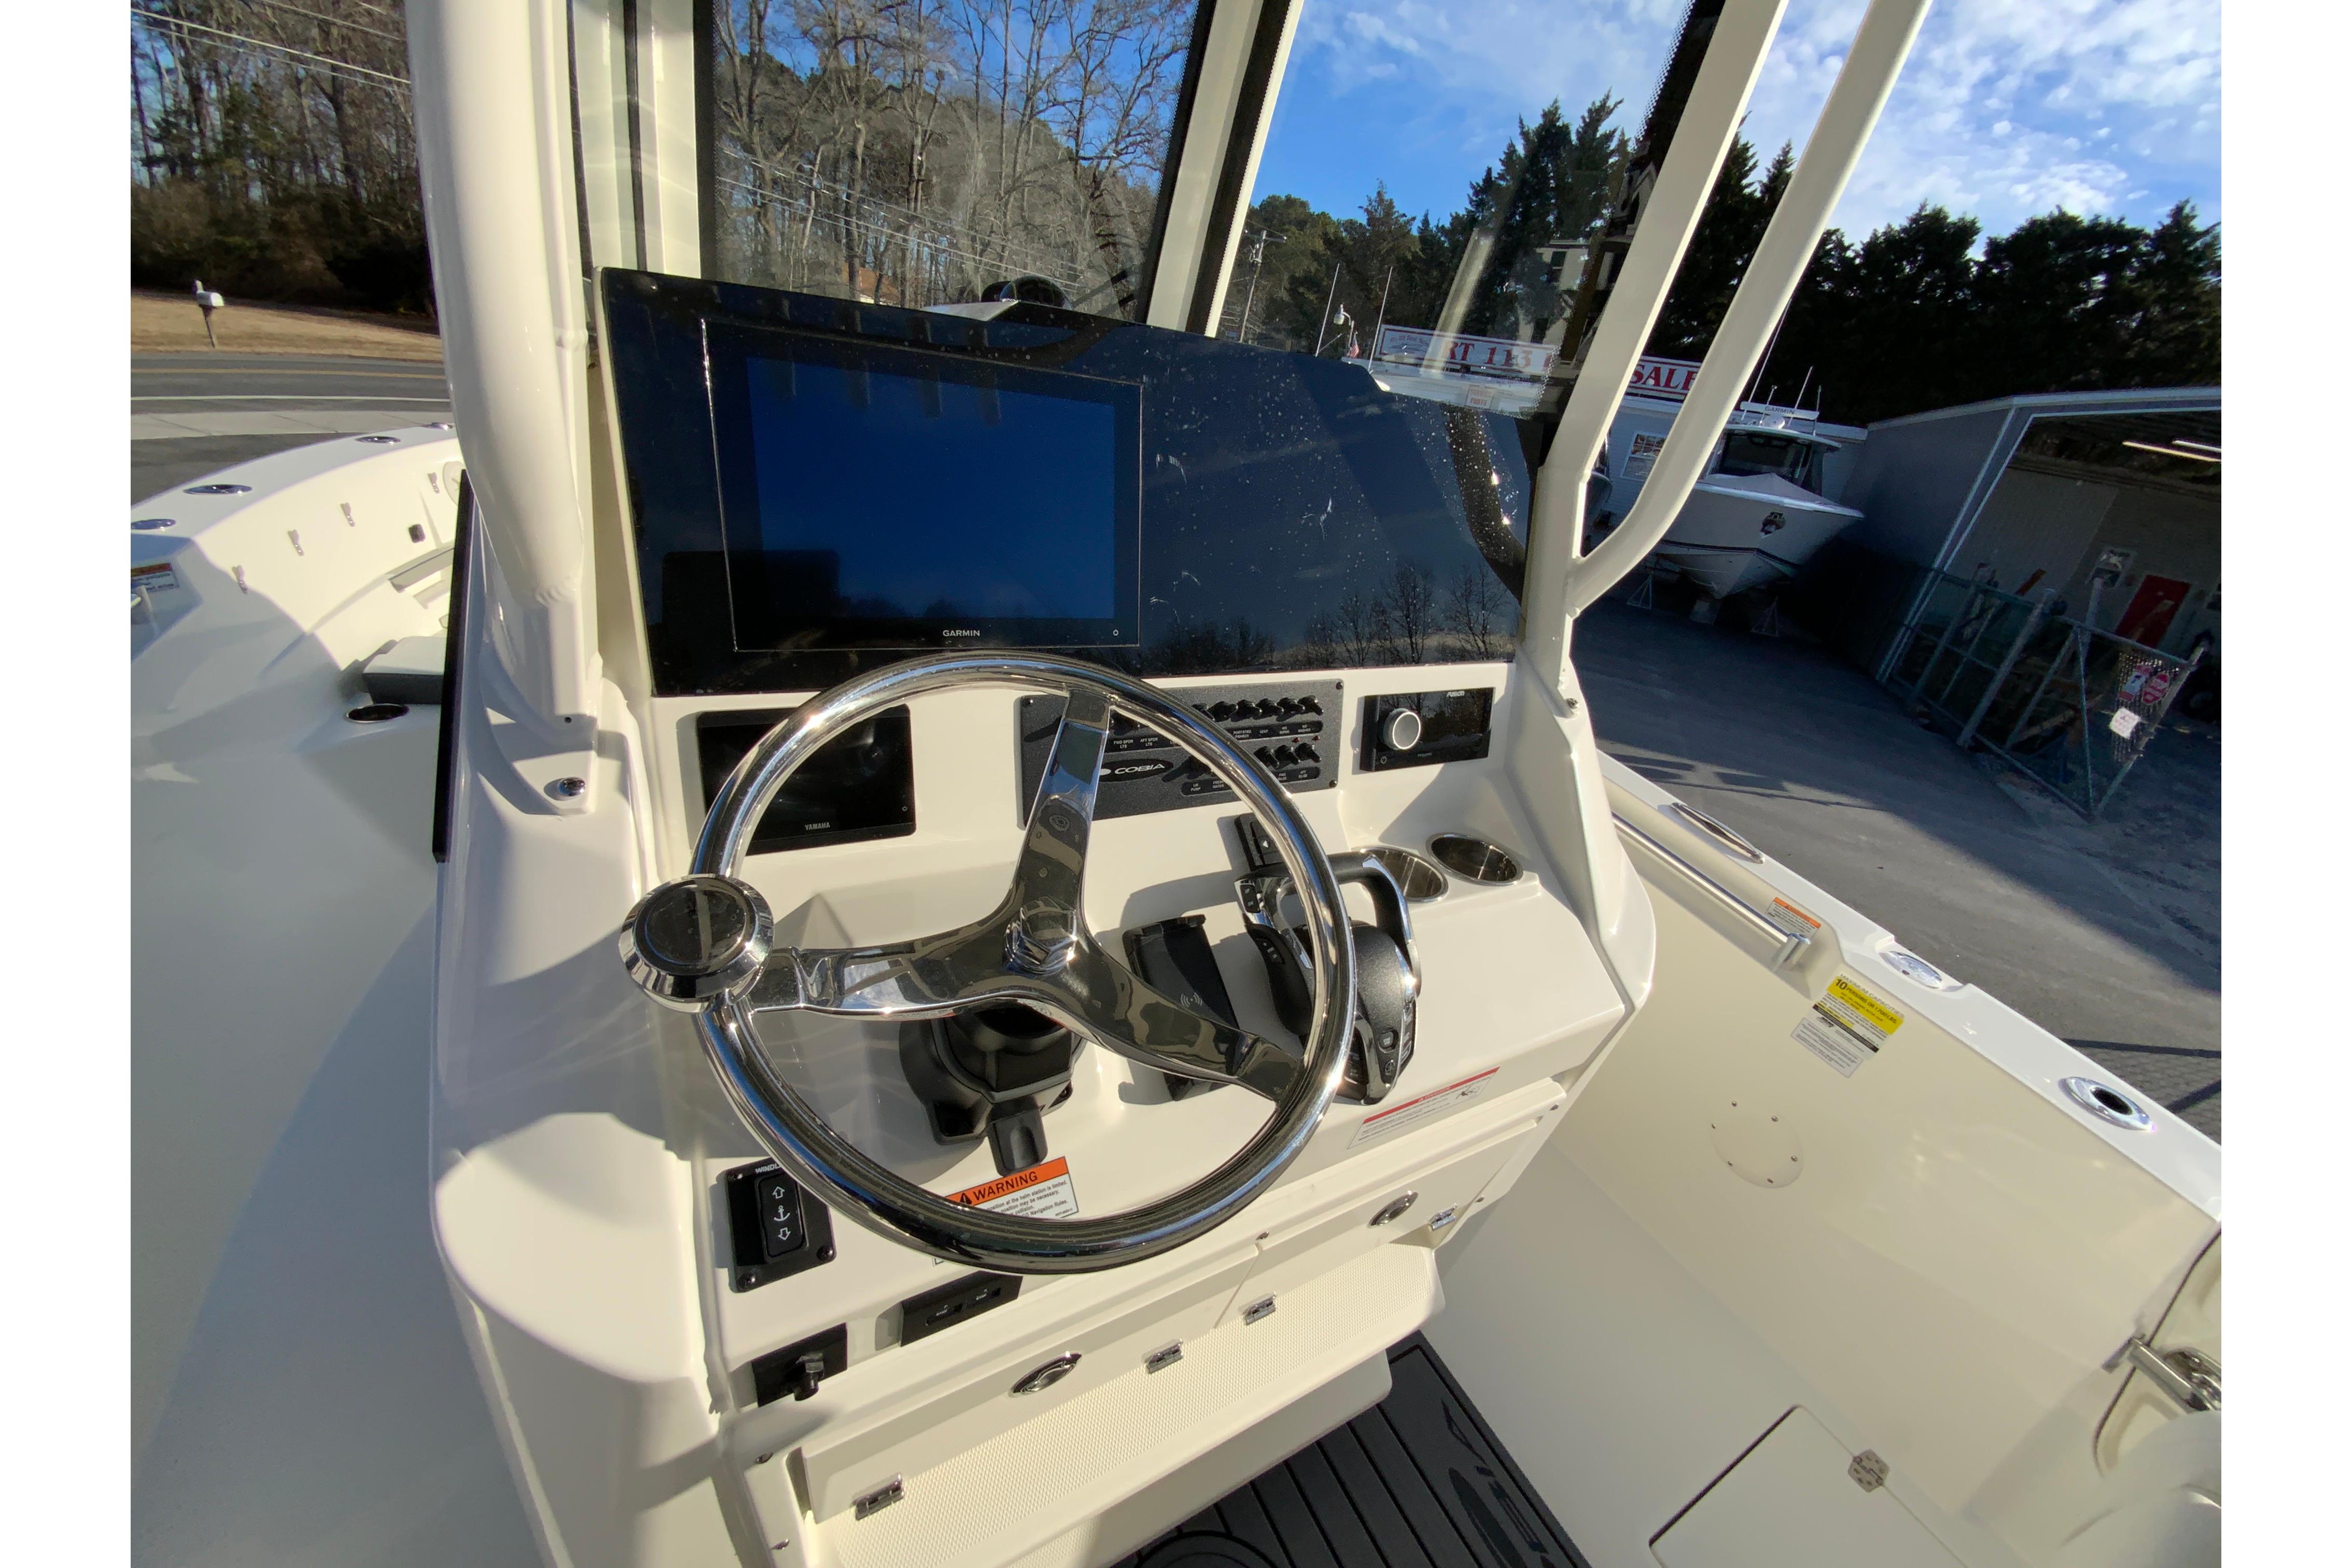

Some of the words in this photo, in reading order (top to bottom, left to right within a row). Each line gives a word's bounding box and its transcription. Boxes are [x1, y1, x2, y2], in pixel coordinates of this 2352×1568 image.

[1483, 346, 1533, 369] 113
[1765, 405, 1796, 415] GARMIN
[1114, 763, 1166, 775] COBIA
[804, 822, 831, 831] YAMAHA
[1836, 978, 1848, 990] 10
[1846, 986, 1867, 1004] PERSONS
[973, 1171, 1039, 1201] WARNING
[1031, 1187, 1046, 1196] station
[1052, 1179, 1068, 1188] limited.
[1036, 1190, 1060, 1201] necessary.
[1030, 1204, 1054, 1216] Navigation
[1054, 1199, 1068, 1208] Rules.
